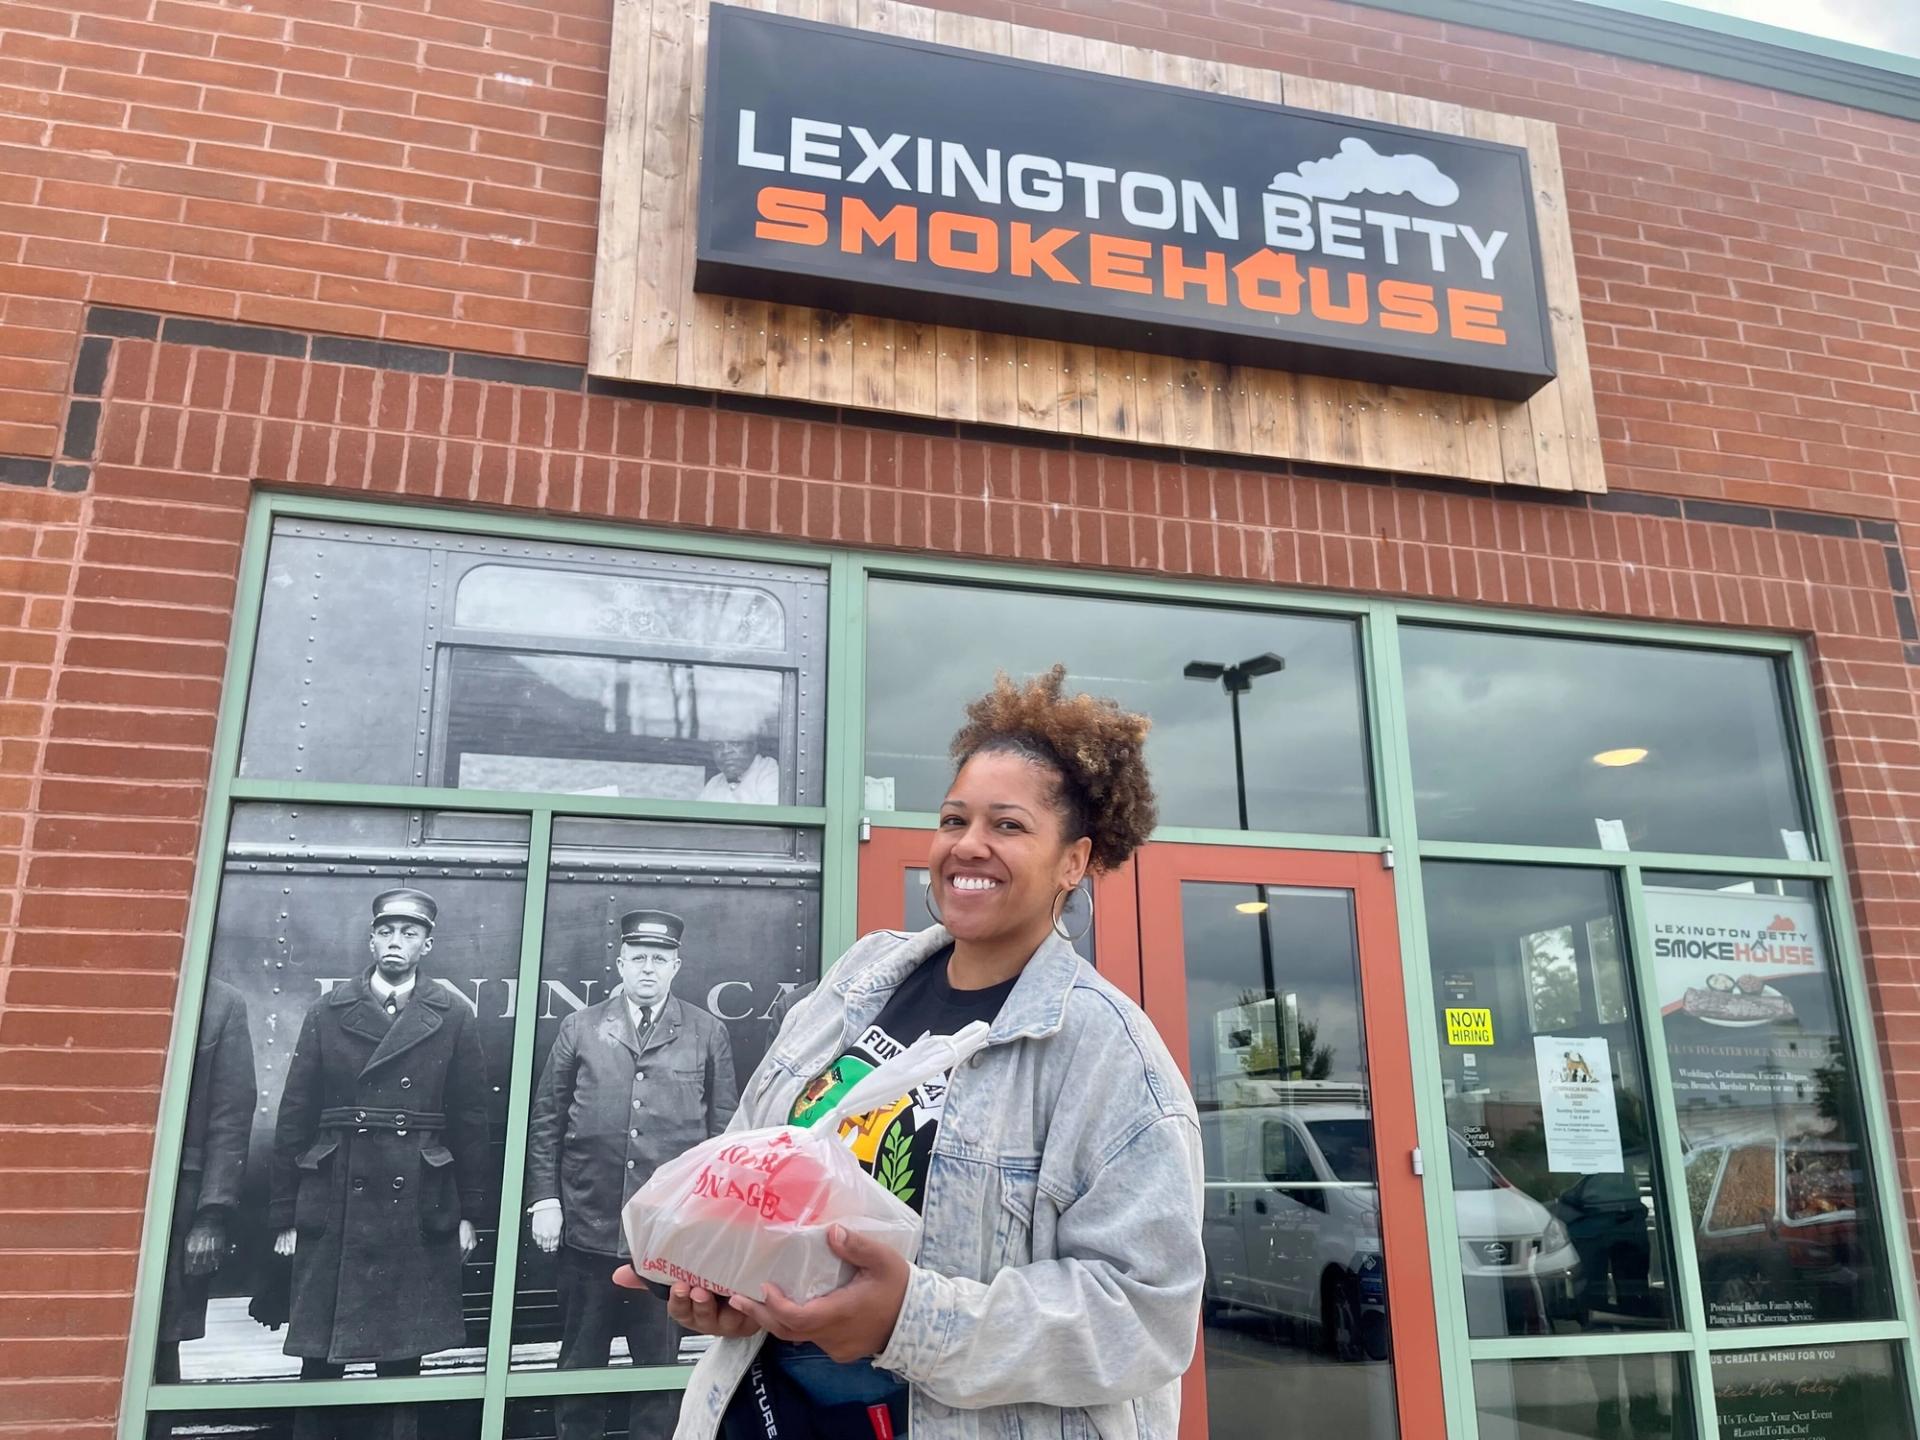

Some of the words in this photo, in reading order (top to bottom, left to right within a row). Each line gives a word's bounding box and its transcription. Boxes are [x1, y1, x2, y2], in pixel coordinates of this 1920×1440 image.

[738, 109, 1239, 240] LEXINGTON
[1262, 192, 1509, 280] BETTY
[755, 186, 1507, 345] SMOKEHOUSE
[1655, 924, 1750, 938] LEXINGTON
[1758, 930, 1808, 942] BETTY
[1655, 938, 1815, 966] SMOKEHOUSE
[1450, 1012, 1486, 1028] NOW
[1452, 1030, 1489, 1042] HIRING
[669, 1263, 710, 1288] RECYCLE
[1710, 1302, 1744, 1312] Providing
[1758, 1312, 1788, 1323] Catering
[1724, 1353, 1758, 1364] CREATE
[1760, 1353, 1768, 1362] A
[1769, 1351, 1796, 1361] MENU
[1798, 1351, 1815, 1360] FOR
[1817, 1350, 1836, 1359] YOU
[1737, 1414, 1748, 1424] To
[1749, 1412, 1769, 1423] Cater
[1771, 1411, 1791, 1422] Your
[1793, 1410, 1810, 1421] Next
[1811, 1409, 1832, 1420] Event
